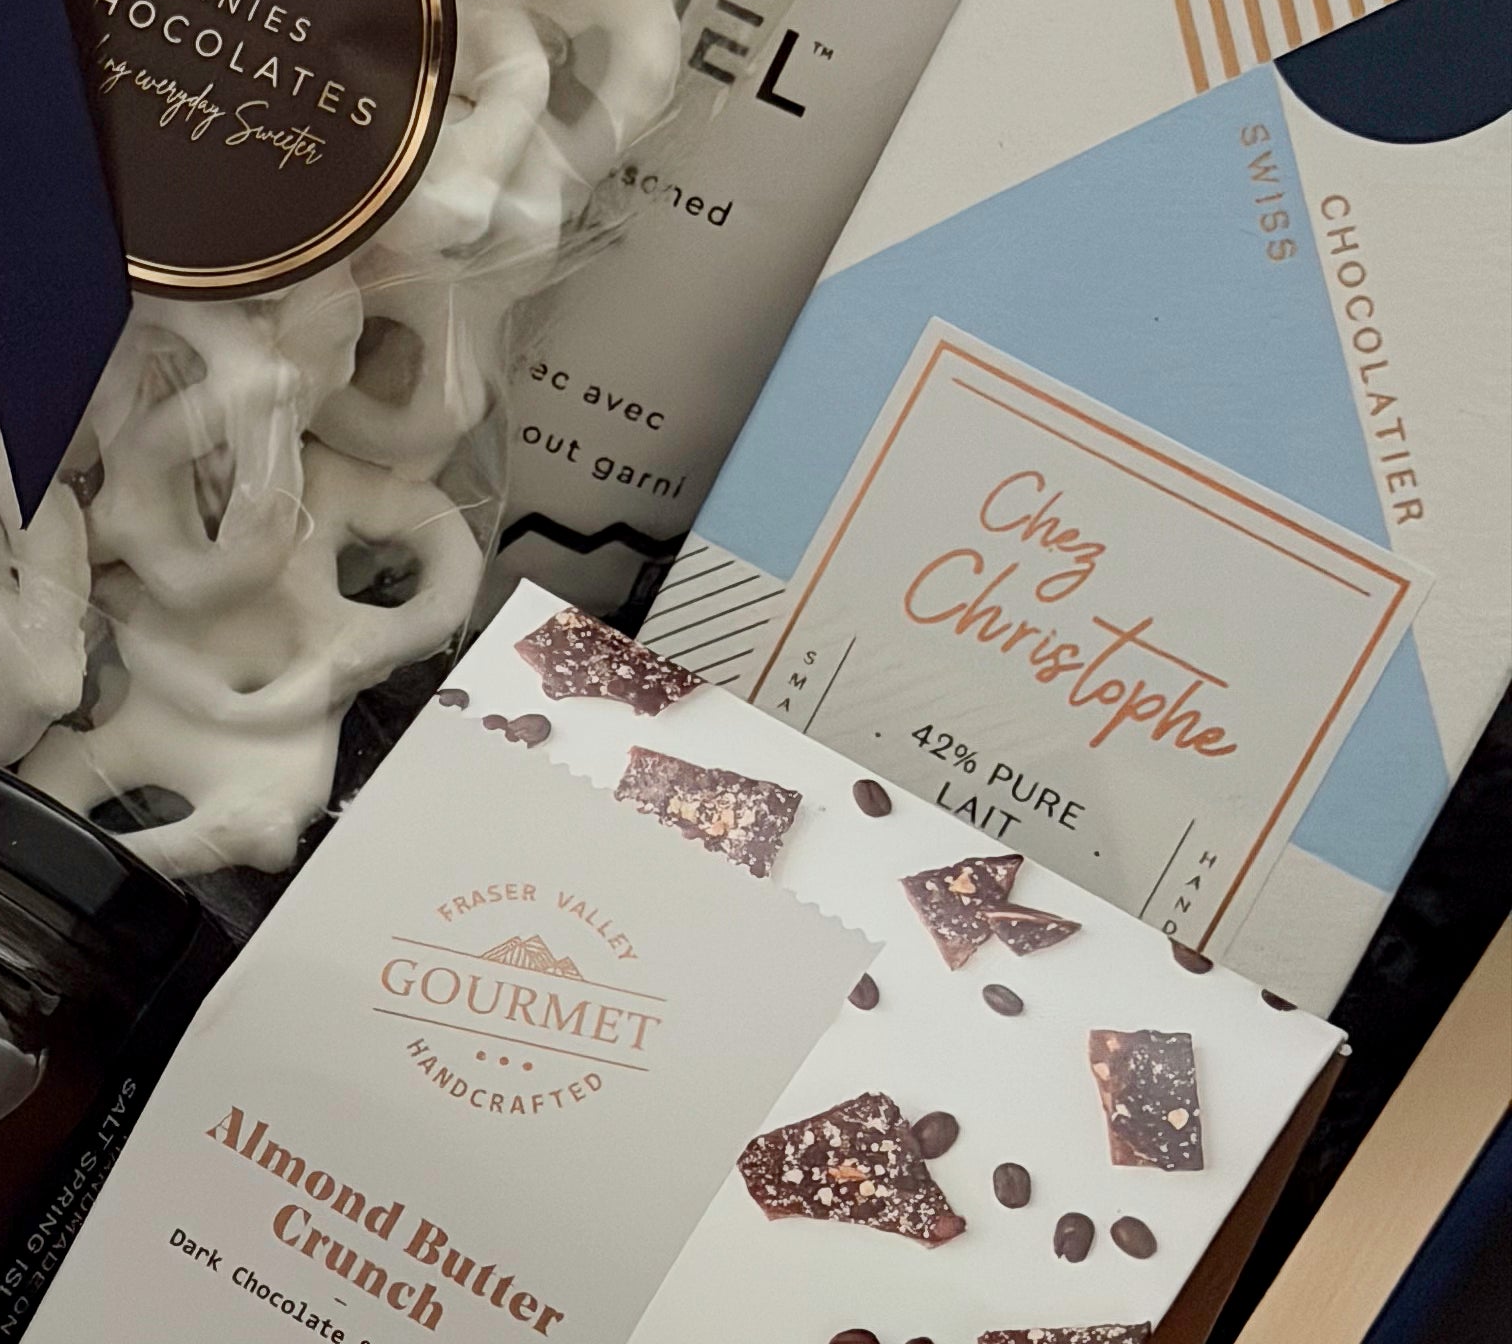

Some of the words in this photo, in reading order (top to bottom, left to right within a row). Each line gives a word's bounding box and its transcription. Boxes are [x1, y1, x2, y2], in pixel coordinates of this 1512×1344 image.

[134, 68, 226, 142] everyday
[225, 99, 327, 170] Sweeter
[1238, 122, 1298, 265] SWISS
[1319, 192, 1425, 527] CHOCOLATIER
[529, 362, 570, 391] ec
[583, 385, 665, 430] avec
[522, 425, 580, 463] out
[591, 456, 687, 499] garni
[978, 470, 1109, 602] Chez
[902, 547, 1239, 759] Christophe
[911, 724, 978, 775] 42%
[987, 763, 1086, 830] PURE
[936, 781, 1022, 838] LAIT
[437, 882, 538, 923] FRASER
[557, 890, 639, 962] VALLEY
[380, 957, 664, 1053] GOURMET
[98, 1077, 137, 1150] SALT
[405, 1036, 606, 1115] HANDCRAFTED
[26, 1150, 97, 1254] SPRING
[205, 1105, 406, 1241] Almond
[403, 1213, 565, 1338] Butter
[169, 1228, 225, 1273] Dark
[272, 1204, 446, 1331] Crunch
[0, 1295, 29, 1336] ON
